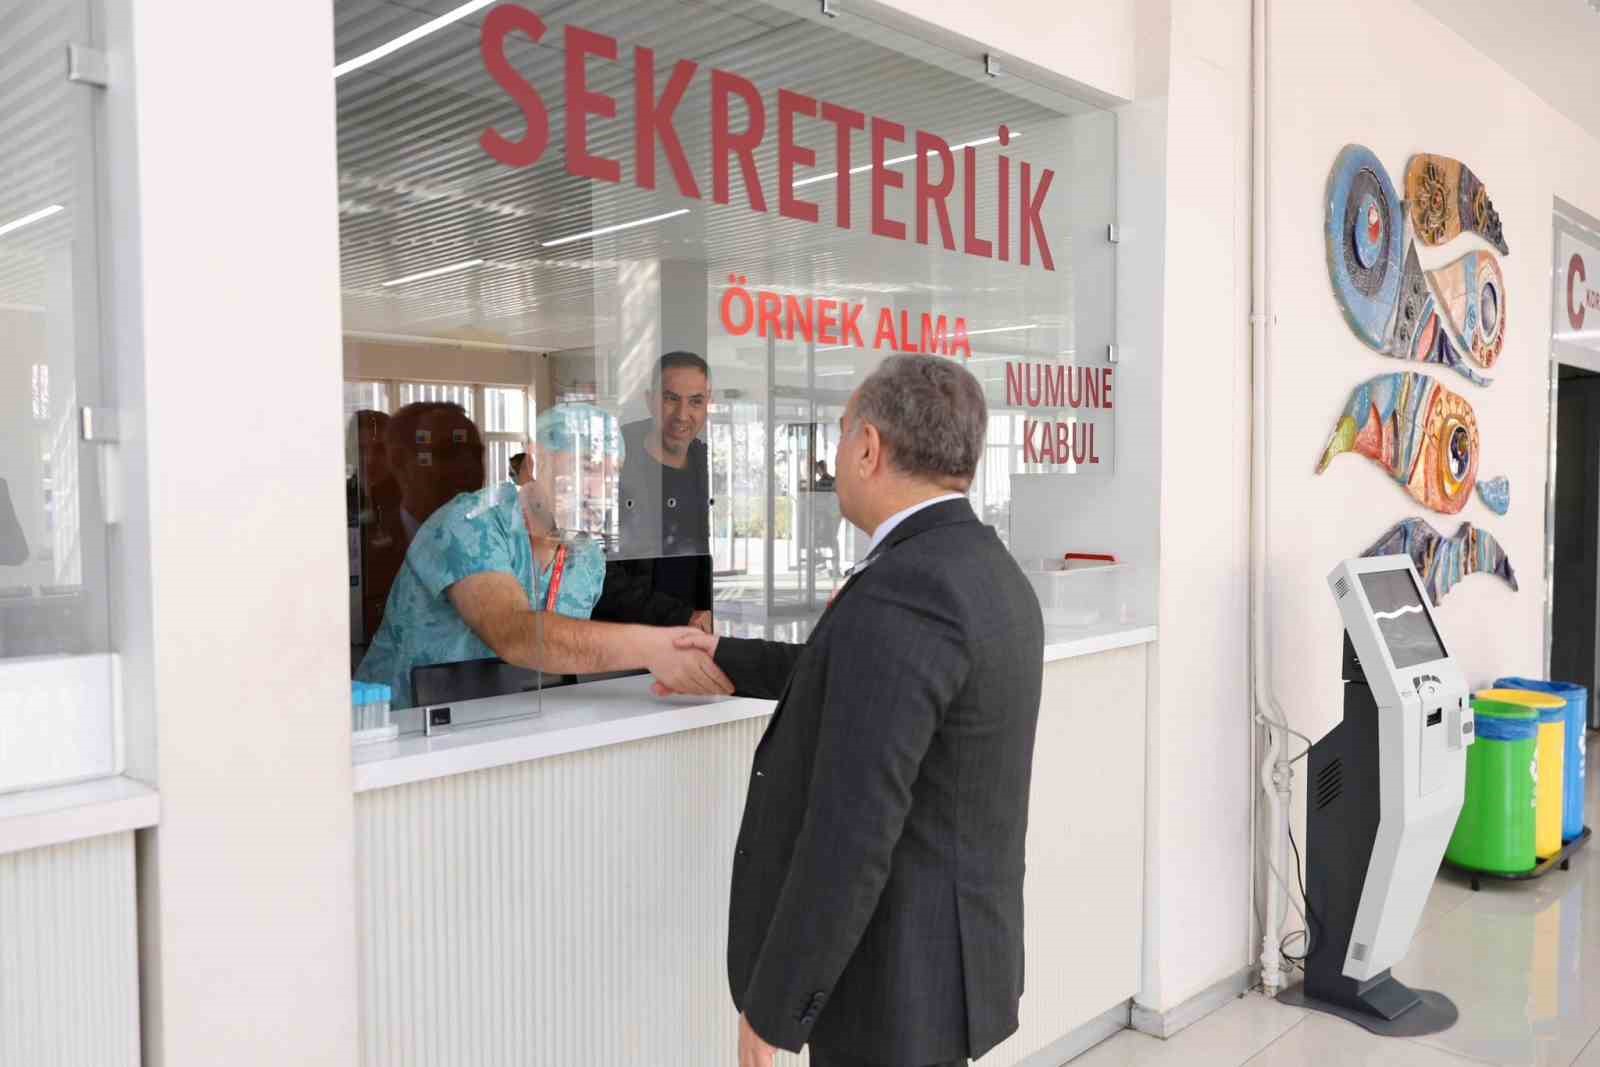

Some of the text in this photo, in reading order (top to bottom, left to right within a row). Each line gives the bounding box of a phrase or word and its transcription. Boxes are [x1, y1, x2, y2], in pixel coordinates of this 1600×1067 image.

[479, 3, 1056, 271] SEKRETERLİK
[719, 273, 973, 358] ÖRNEK ALMA
[1567, 254, 1586, 330] C
[1005, 361, 1112, 409] NUMUNE
[1023, 420, 1099, 464] KABUL
